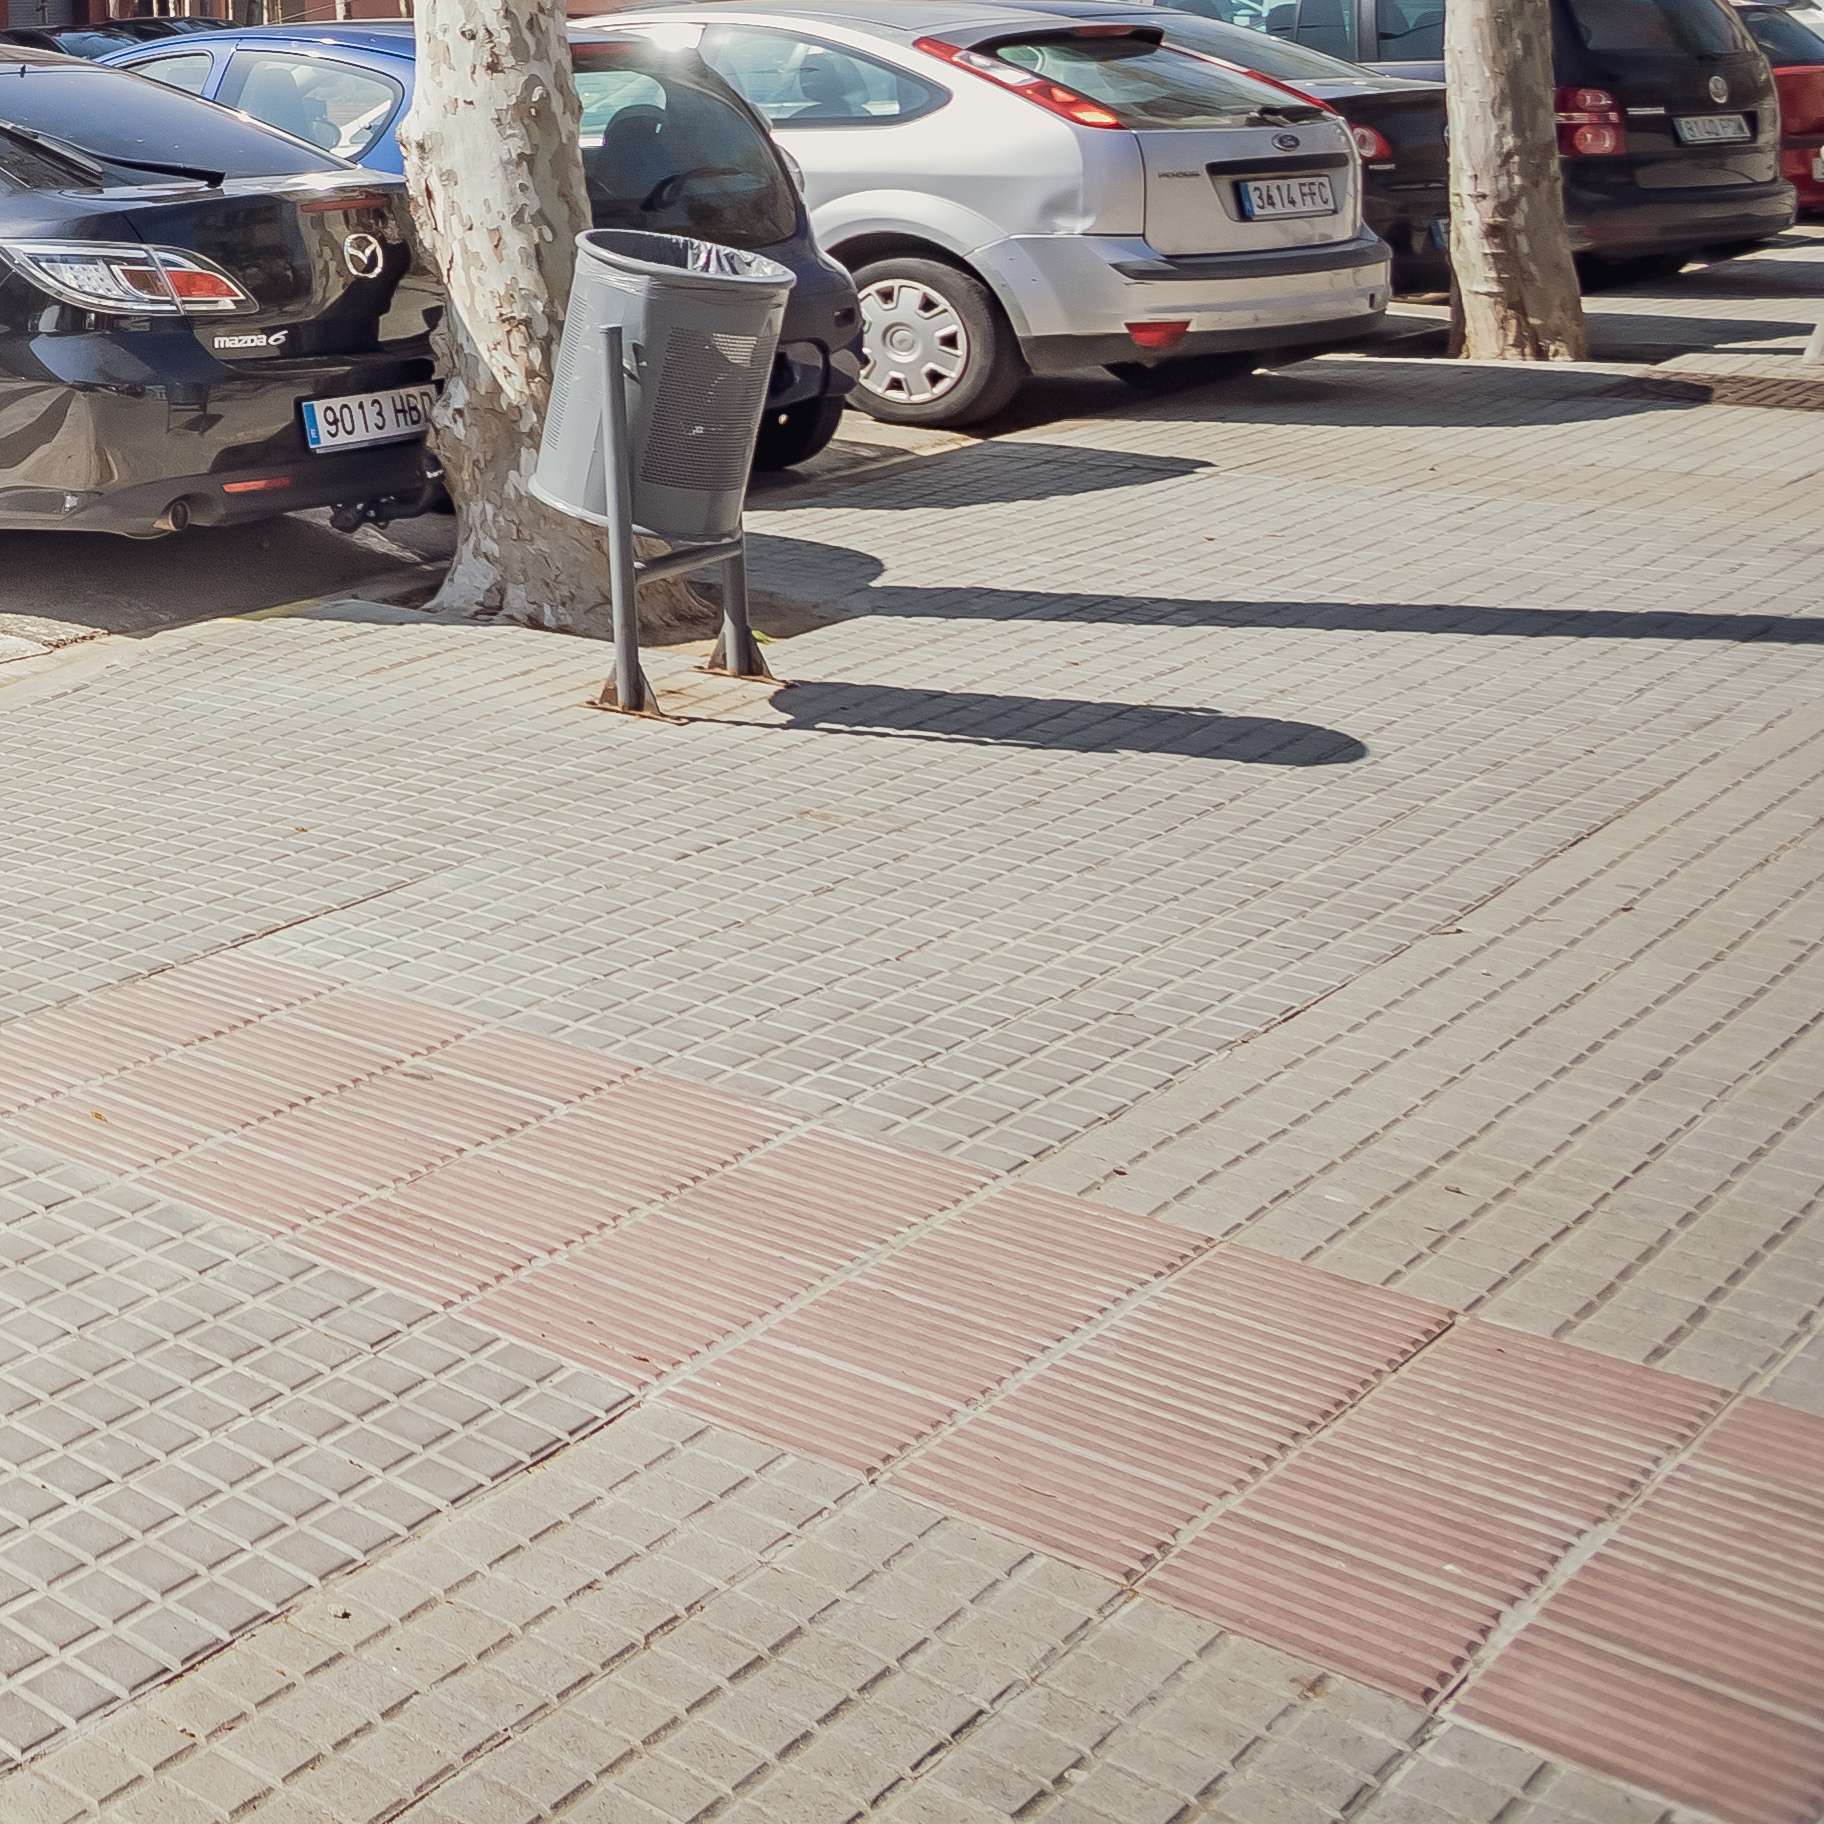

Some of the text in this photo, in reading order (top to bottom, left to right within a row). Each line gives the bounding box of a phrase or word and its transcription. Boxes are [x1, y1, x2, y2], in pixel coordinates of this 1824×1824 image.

[1252, 181, 1329, 210] 3414 FFC
[323, 398, 387, 439] 9013
